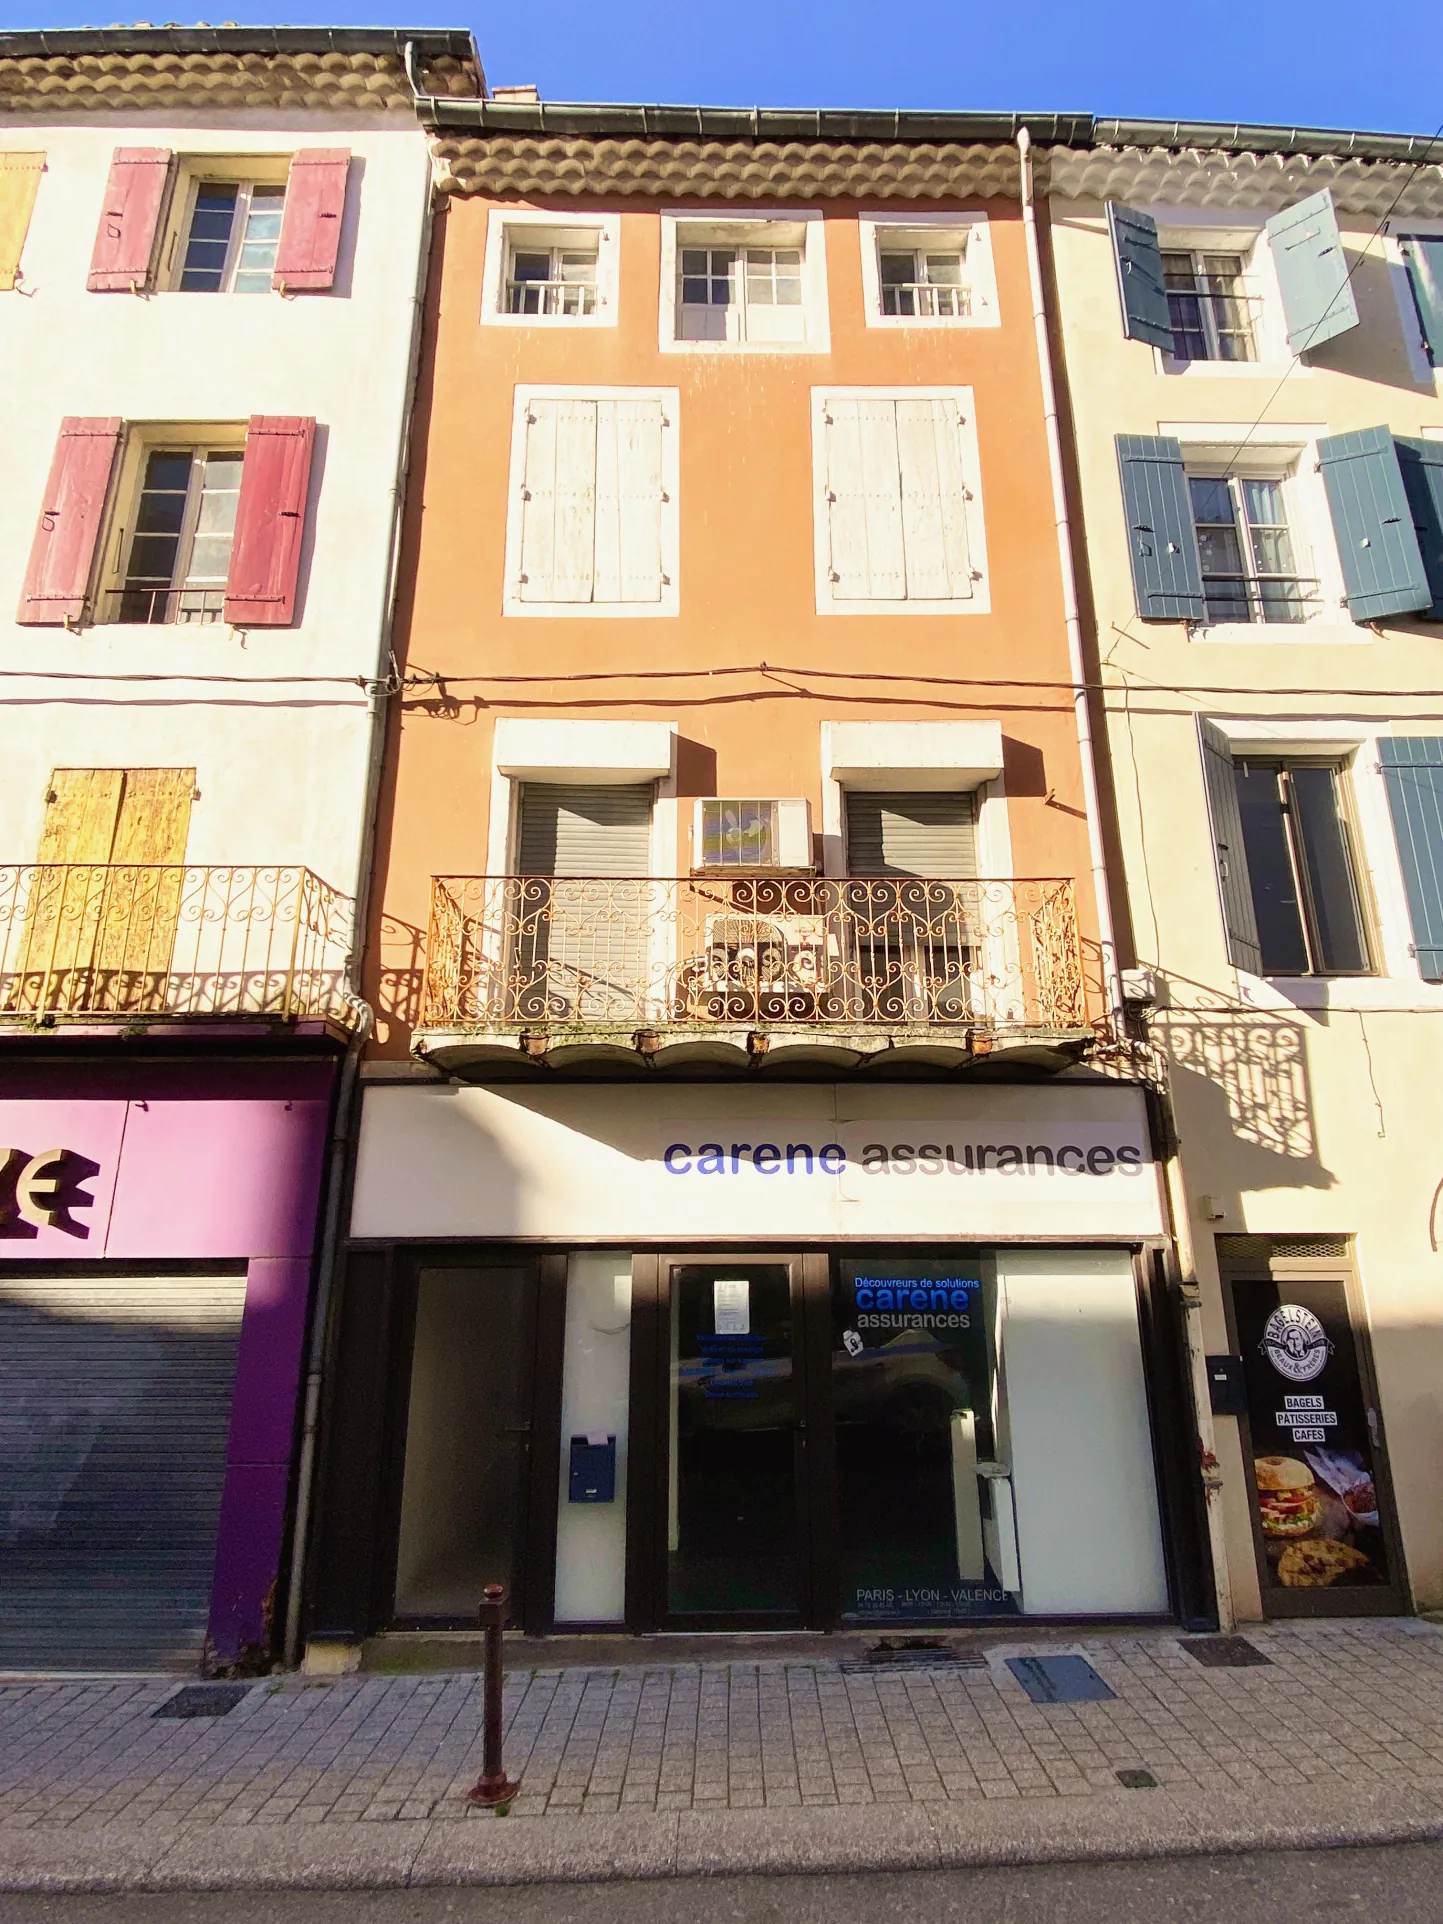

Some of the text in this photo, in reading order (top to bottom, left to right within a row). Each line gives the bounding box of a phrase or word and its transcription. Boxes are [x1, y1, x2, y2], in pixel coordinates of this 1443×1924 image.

[663, 1142, 1144, 1177] carene assurances
[854, 1277, 980, 1289] Découvreurs de solutions
[855, 1289, 969, 1311] carene
[857, 1313, 971, 1328] assurances
[1267, 1308, 1323, 1340] BAGELSTEIN
[1293, 1362, 1303, 1374] &
[1286, 1397, 1322, 1408] BAGELS
[856, 1588, 895, 1602] PARIS
[905, 1588, 940, 1602] LYON
[950, 1588, 1008, 1602] VALENCE
